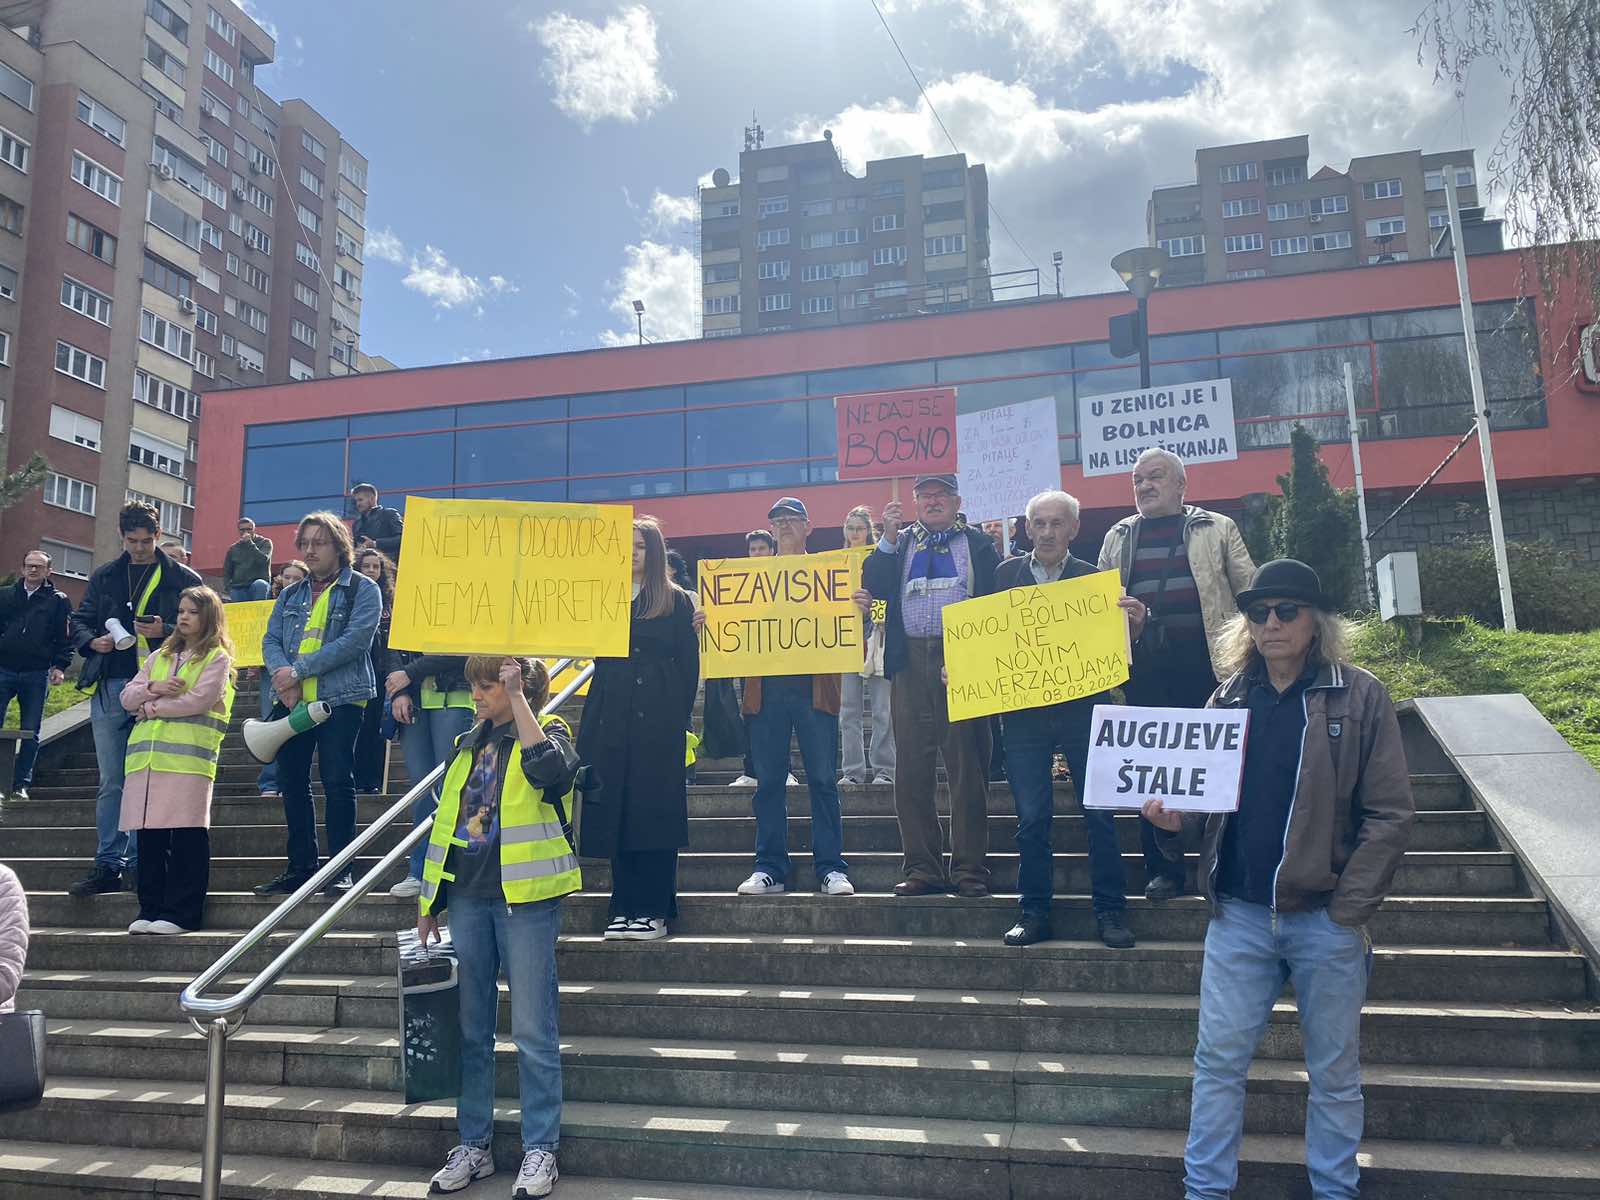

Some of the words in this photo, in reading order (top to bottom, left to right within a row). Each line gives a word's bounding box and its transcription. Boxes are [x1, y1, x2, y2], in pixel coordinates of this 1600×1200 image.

[1091, 401, 1103, 416] U
[1111, 392, 1174, 414] ZENICI
[1182, 388, 1203, 405] JE
[1211, 386, 1218, 402] I
[1102, 414, 1210, 441] BOLNICA
[844, 427, 951, 468] BOSNO
[1089, 451, 1110, 469] NA
[1115, 446, 1150, 465] LIST
[420, 514, 502, 558] NEMA
[518, 514, 627, 564] ODGOVORA,
[413, 581, 496, 626] NEMA
[511, 579, 630, 625] NAPRETKA
[701, 569, 852, 606] NEZAVISNE
[1009, 587, 1049, 608] DA
[700, 616, 857, 654] INSTITUCIJE
[946, 613, 1010, 643] NOVOJ
[1020, 593, 1110, 627] BOLNICI
[1015, 626, 1051, 649] NE
[996, 641, 1080, 674] NOVIM
[951, 652, 1123, 704] MALVERZACIJAMA
[1095, 719, 1241, 751] AUGIJEVE
[1116, 759, 1207, 797] ŠTALE
